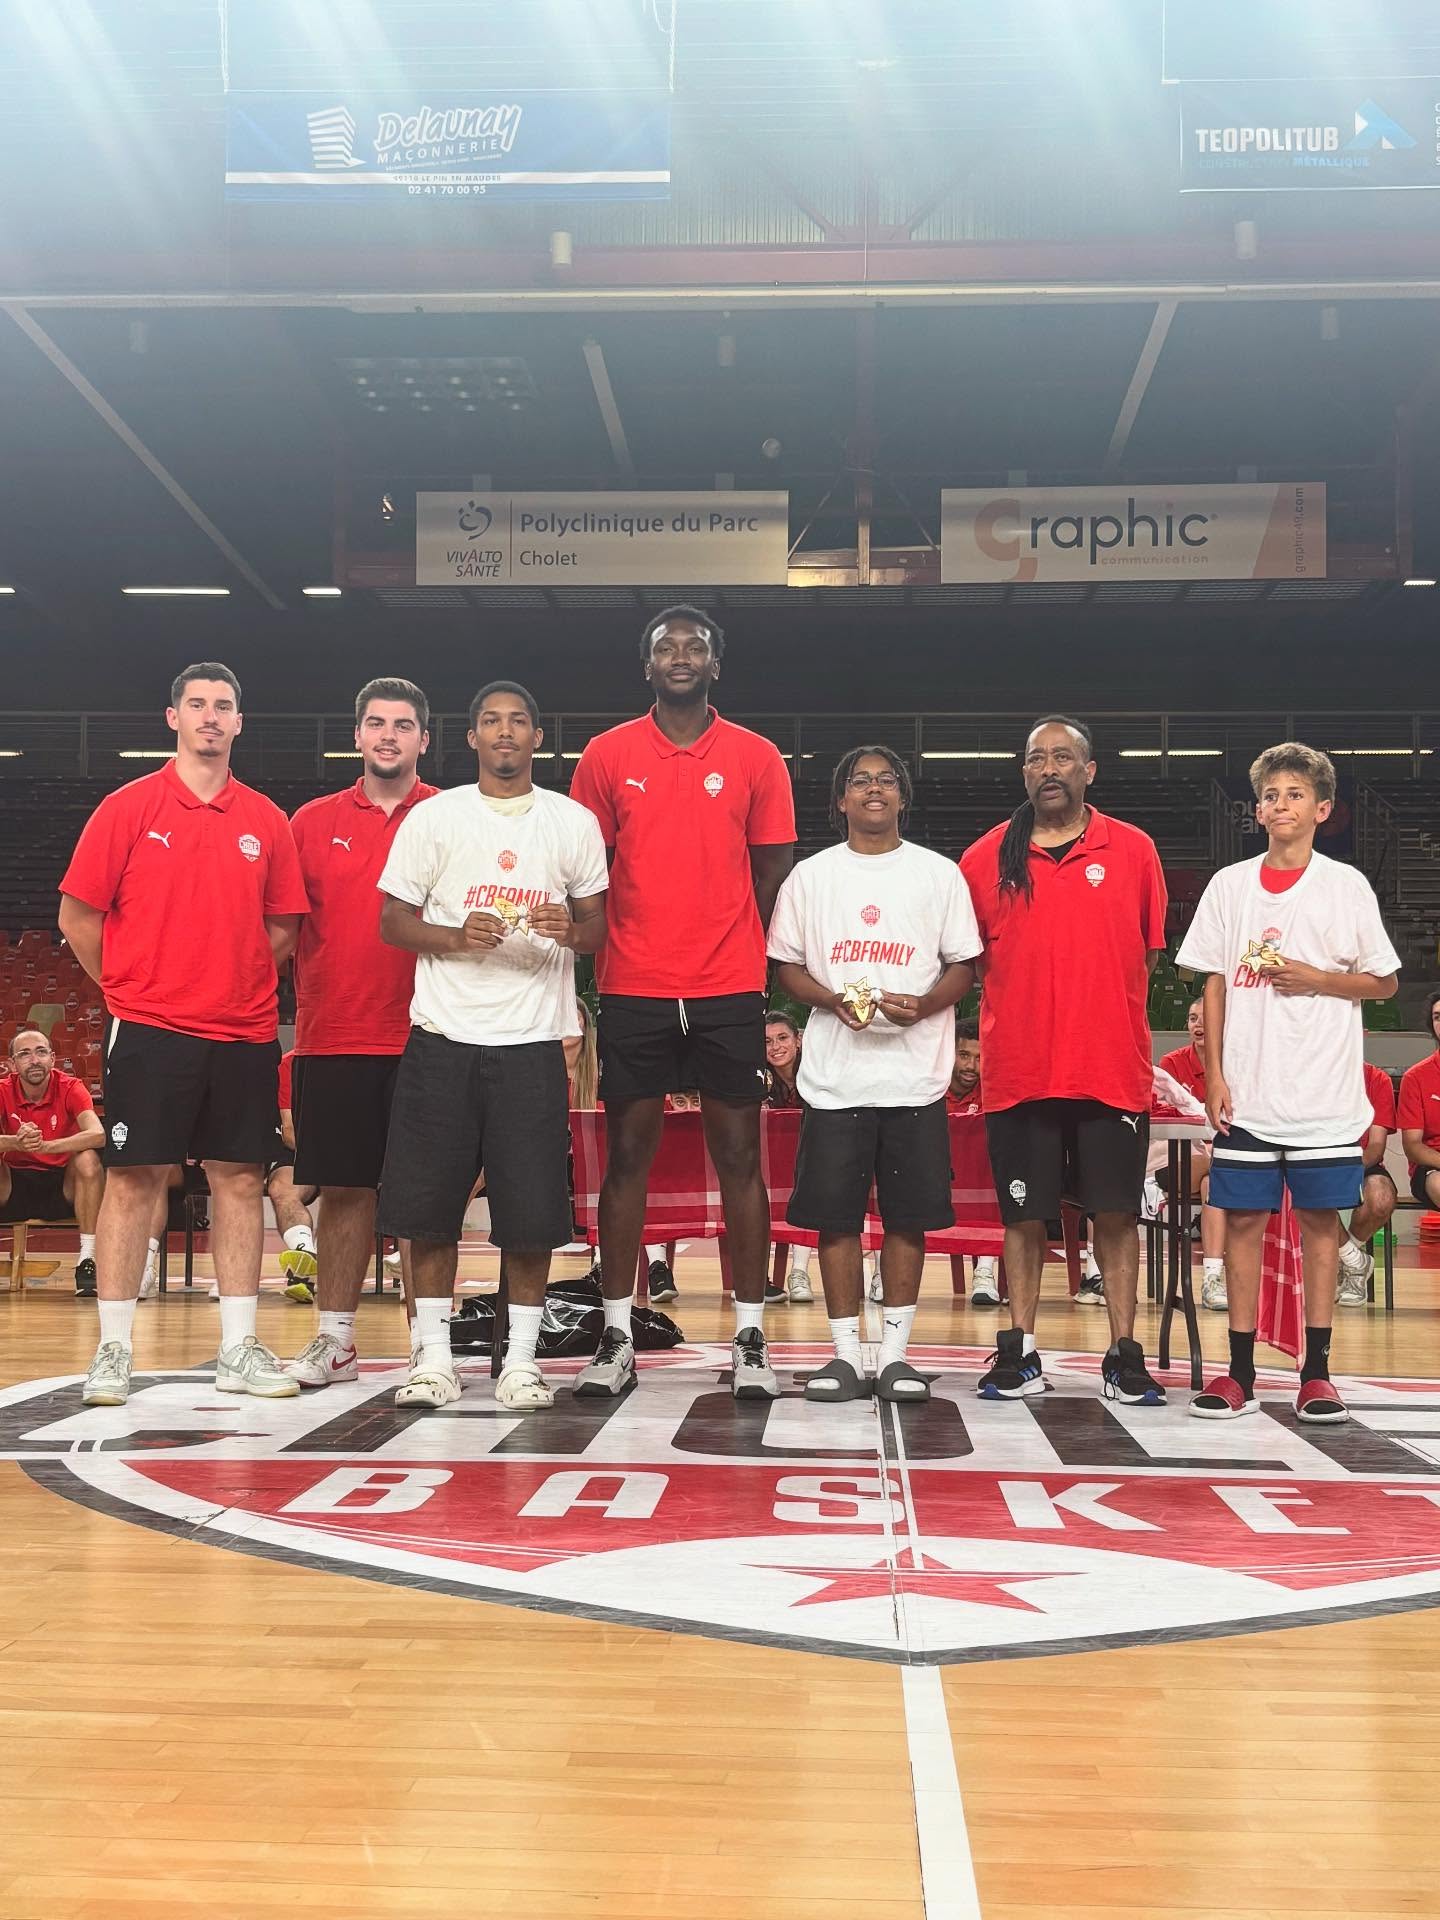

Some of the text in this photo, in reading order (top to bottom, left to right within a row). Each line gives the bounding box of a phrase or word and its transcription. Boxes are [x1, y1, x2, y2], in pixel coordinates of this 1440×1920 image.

[374, 105, 522, 152] Delaunay
[1196, 126, 1339, 152] TEOPOLITUB
[377, 139, 498, 165] MAÇONNERIE
[408, 185, 486, 195] 02 41 70 00 95
[520, 512, 758, 537] Polyclinique du Parc
[447, 549, 503, 563] VIVALTO
[520, 550, 577, 566] Cholet
[1102, 555, 1208, 565] communication
[830, 940, 916, 966] #CBFAMILY
